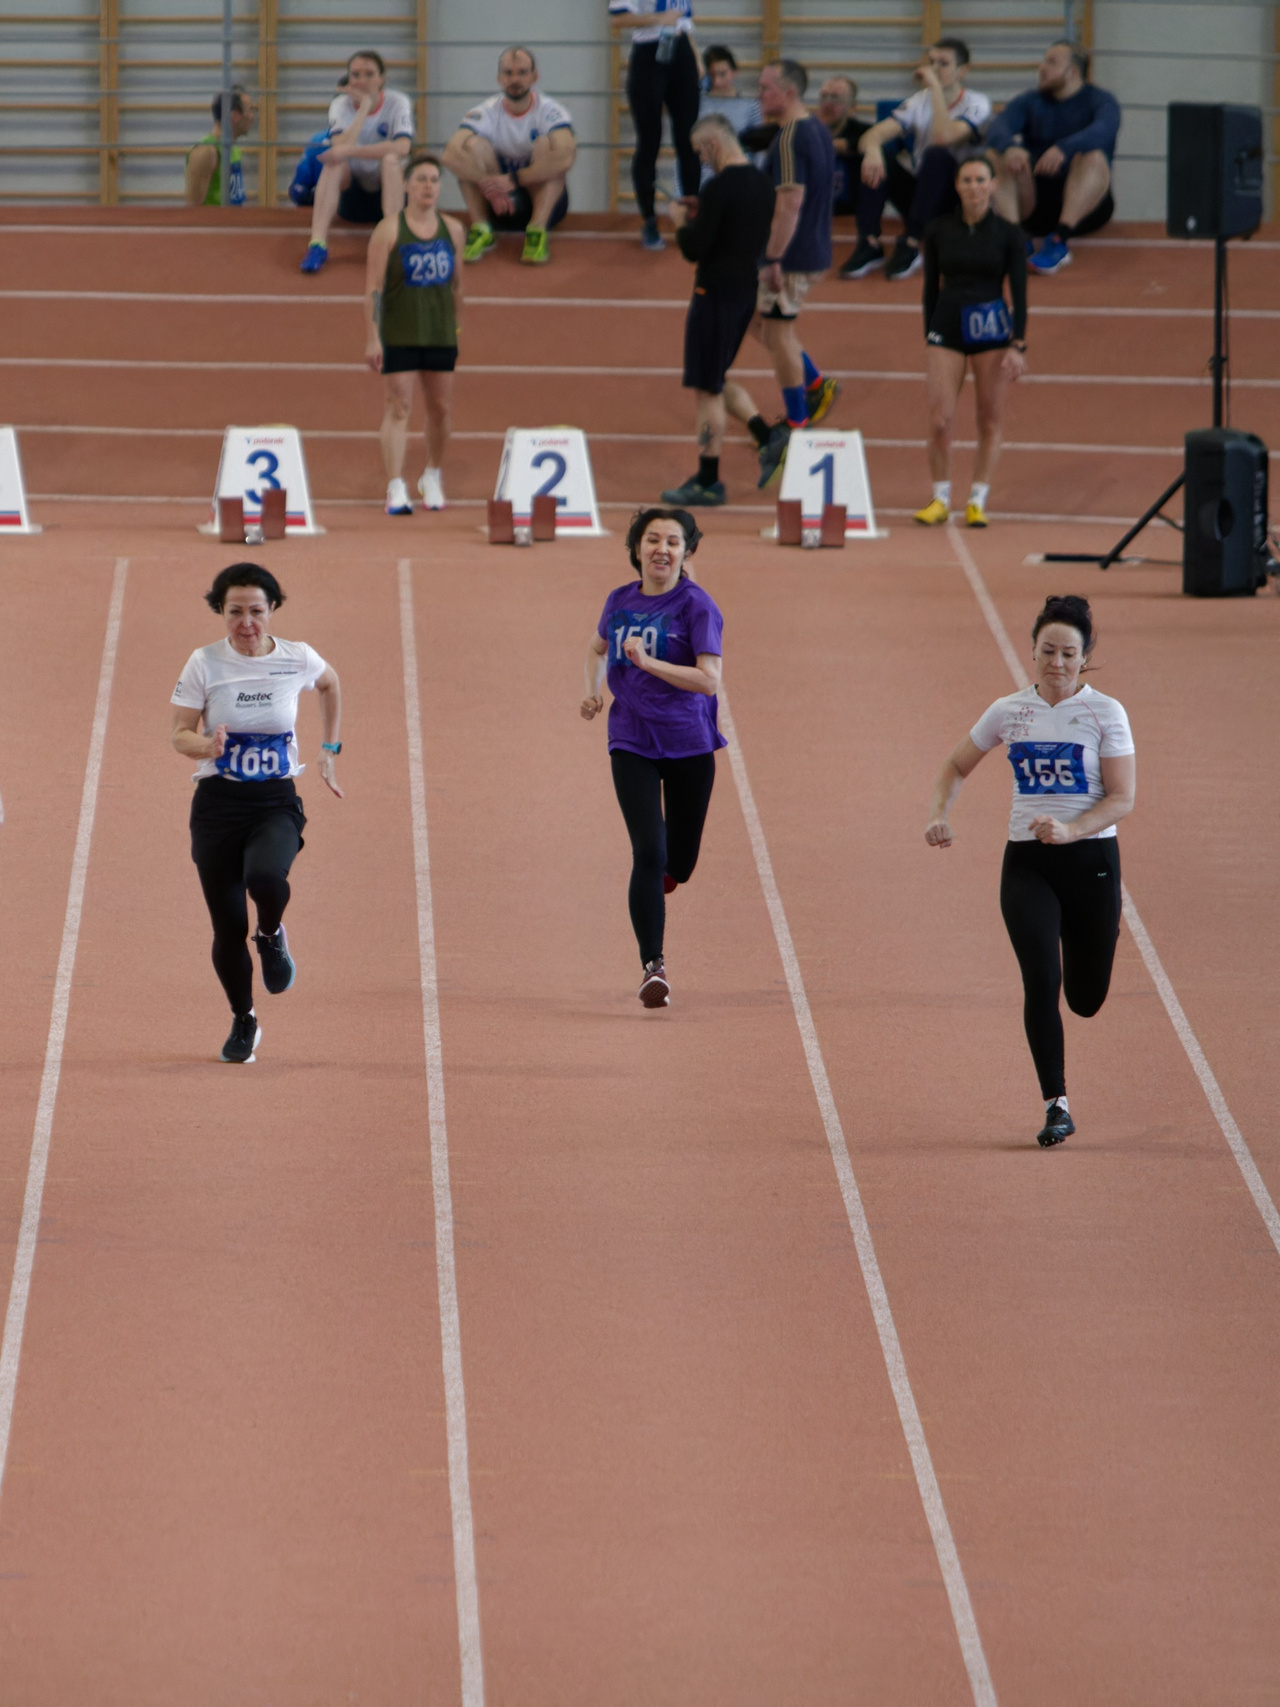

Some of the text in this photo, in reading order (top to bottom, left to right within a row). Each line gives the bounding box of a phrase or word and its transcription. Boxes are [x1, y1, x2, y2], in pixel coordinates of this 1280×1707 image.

[409, 251, 451, 280] 236
[245, 449, 281, 505] 3
[531, 450, 567, 507] 2
[809, 453, 834, 505] 1
[236, 692, 273, 702] Rostec
[229, 744, 279, 776] 165
[1019, 758, 1075, 787] 155
